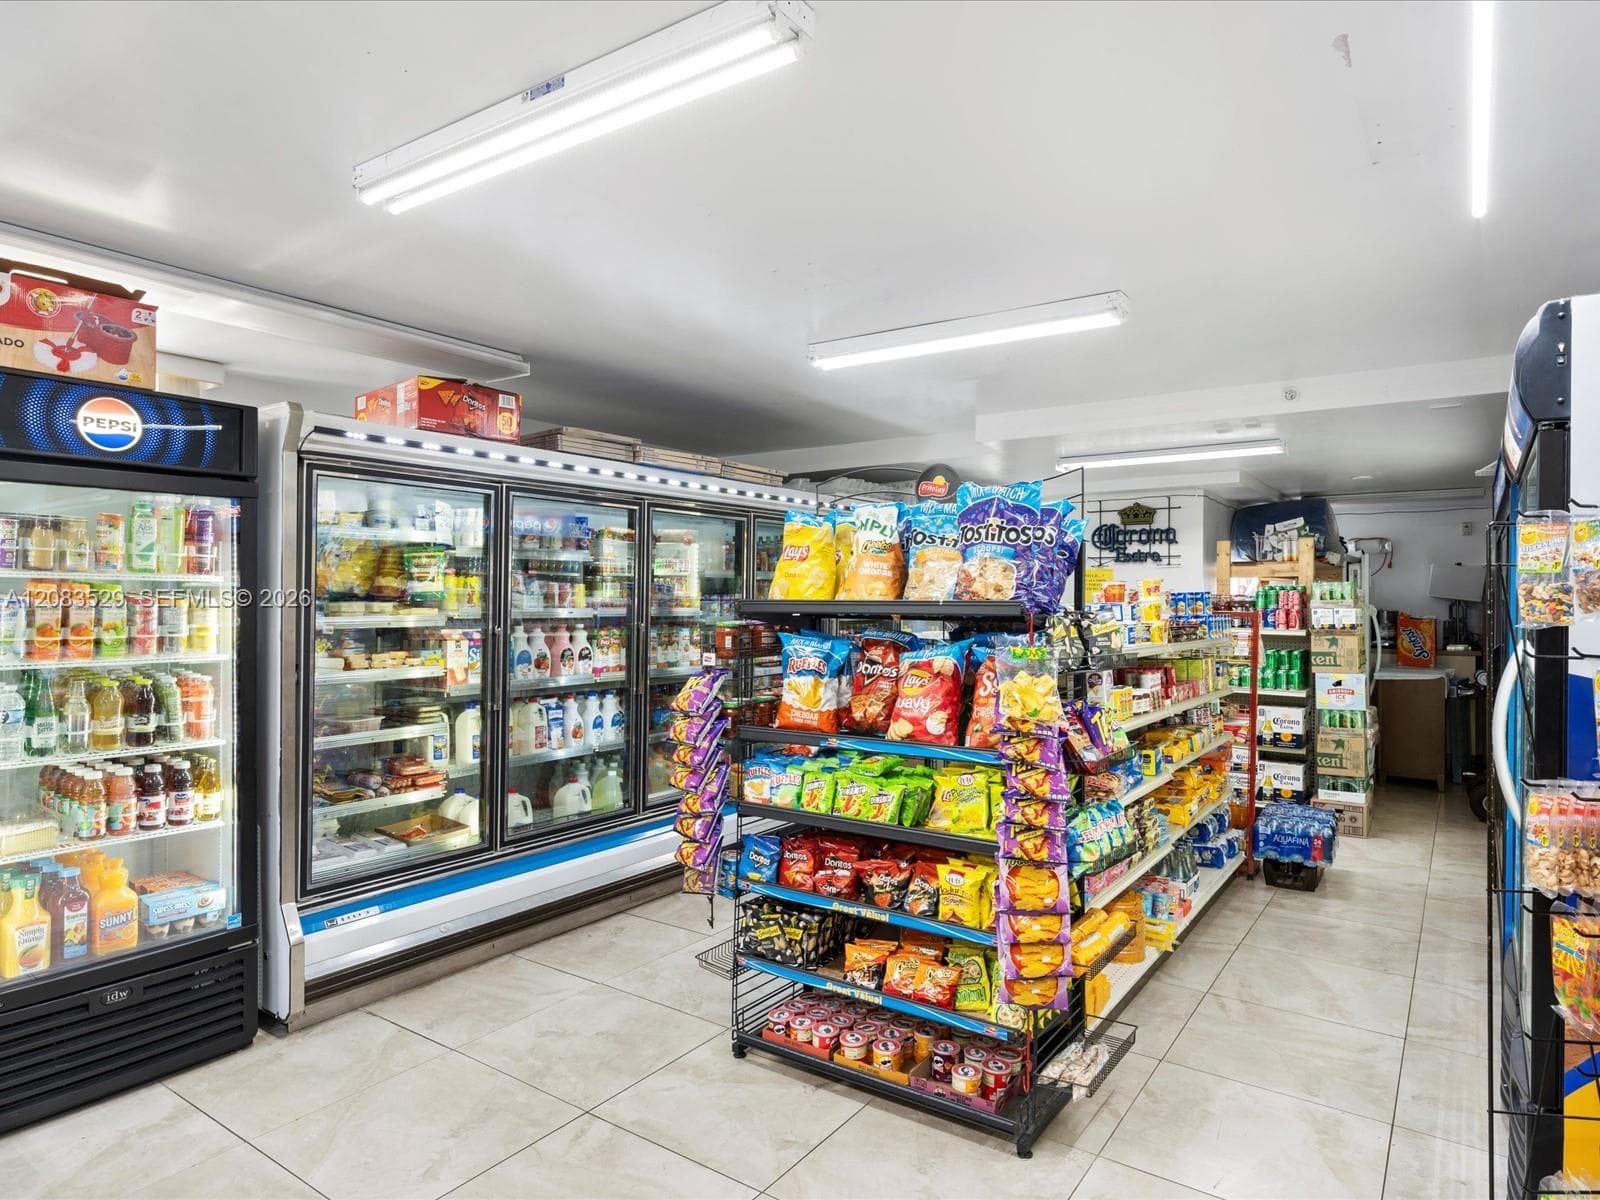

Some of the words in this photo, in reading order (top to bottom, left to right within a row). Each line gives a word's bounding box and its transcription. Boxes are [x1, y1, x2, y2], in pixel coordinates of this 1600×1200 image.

[462, 394, 487, 411] Doritos
[1091, 523, 1178, 552] Corona
[788, 657, 828, 674] RUFFLES
[1272, 716, 1301, 726] Corona
[1272, 772, 1301, 782] Corona
[1273, 834, 1310, 848] AQUAFINA
[749, 852, 771, 866] Doritos
[824, 858, 853, 869] Doritos
[99, 910, 133, 929] SUNNY
[832, 902, 858, 916] Great
[860, 908, 890, 923] Value!
[106, 989, 130, 1003] idw
[825, 981, 851, 997] Great
[854, 989, 882, 1006] Value!
